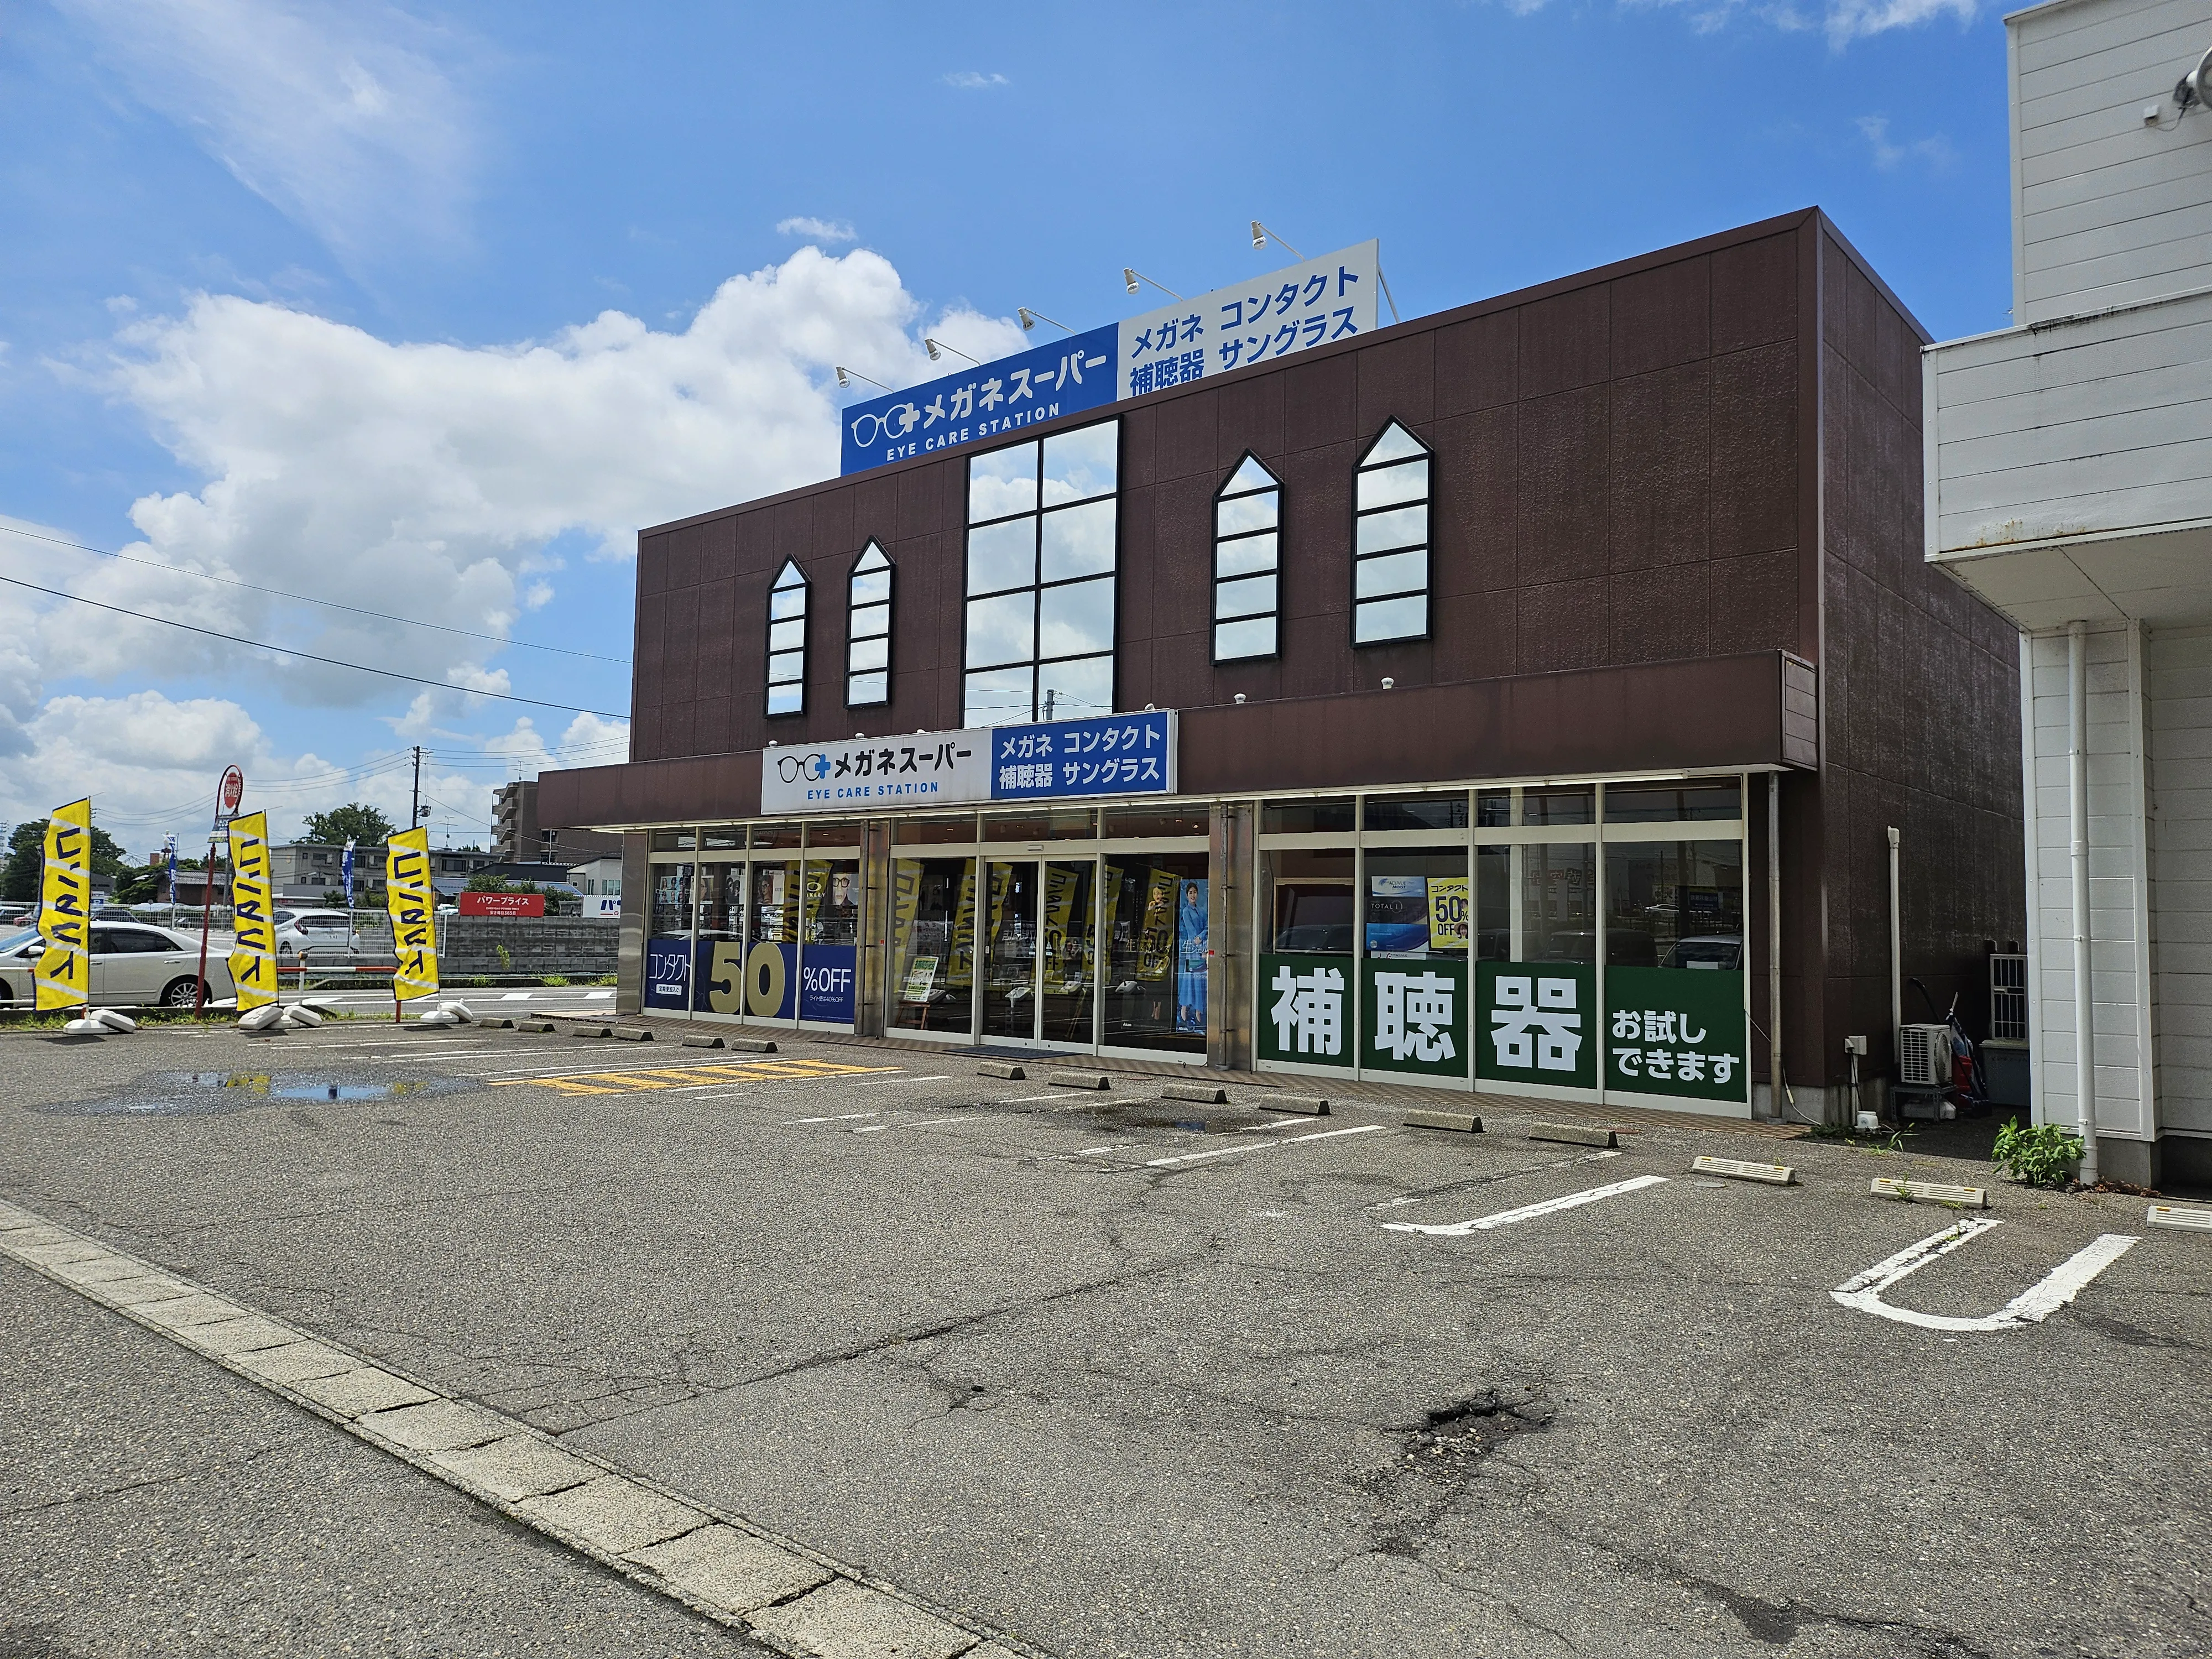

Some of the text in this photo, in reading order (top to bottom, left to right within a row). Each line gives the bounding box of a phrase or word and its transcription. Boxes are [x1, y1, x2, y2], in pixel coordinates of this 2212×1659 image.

[1131, 266, 1359, 359] メガネ コンタクト
[1130, 306, 1358, 397] 補聴器 サングラス
[924, 349, 1107, 429] メガネスーパー
[886, 403, 1059, 461] EYE CARE STATION
[1000, 724, 1160, 759] メガネ コンタクト
[834, 742, 972, 779] メガネスーパー
[999, 757, 1160, 790] 補聴器 サングラス
[807, 781, 938, 800] EYE CARE STATION
[477, 896, 529, 905] パワープライス
[1437, 923, 1455, 936] OFF
[649, 954, 691, 981] コンタクト
[804, 967, 852, 993] %OFF
[1271, 965, 1583, 1072] 補聴器
[1612, 1010, 1707, 1044] お試し
[1612, 1047, 1740, 1085] できます
